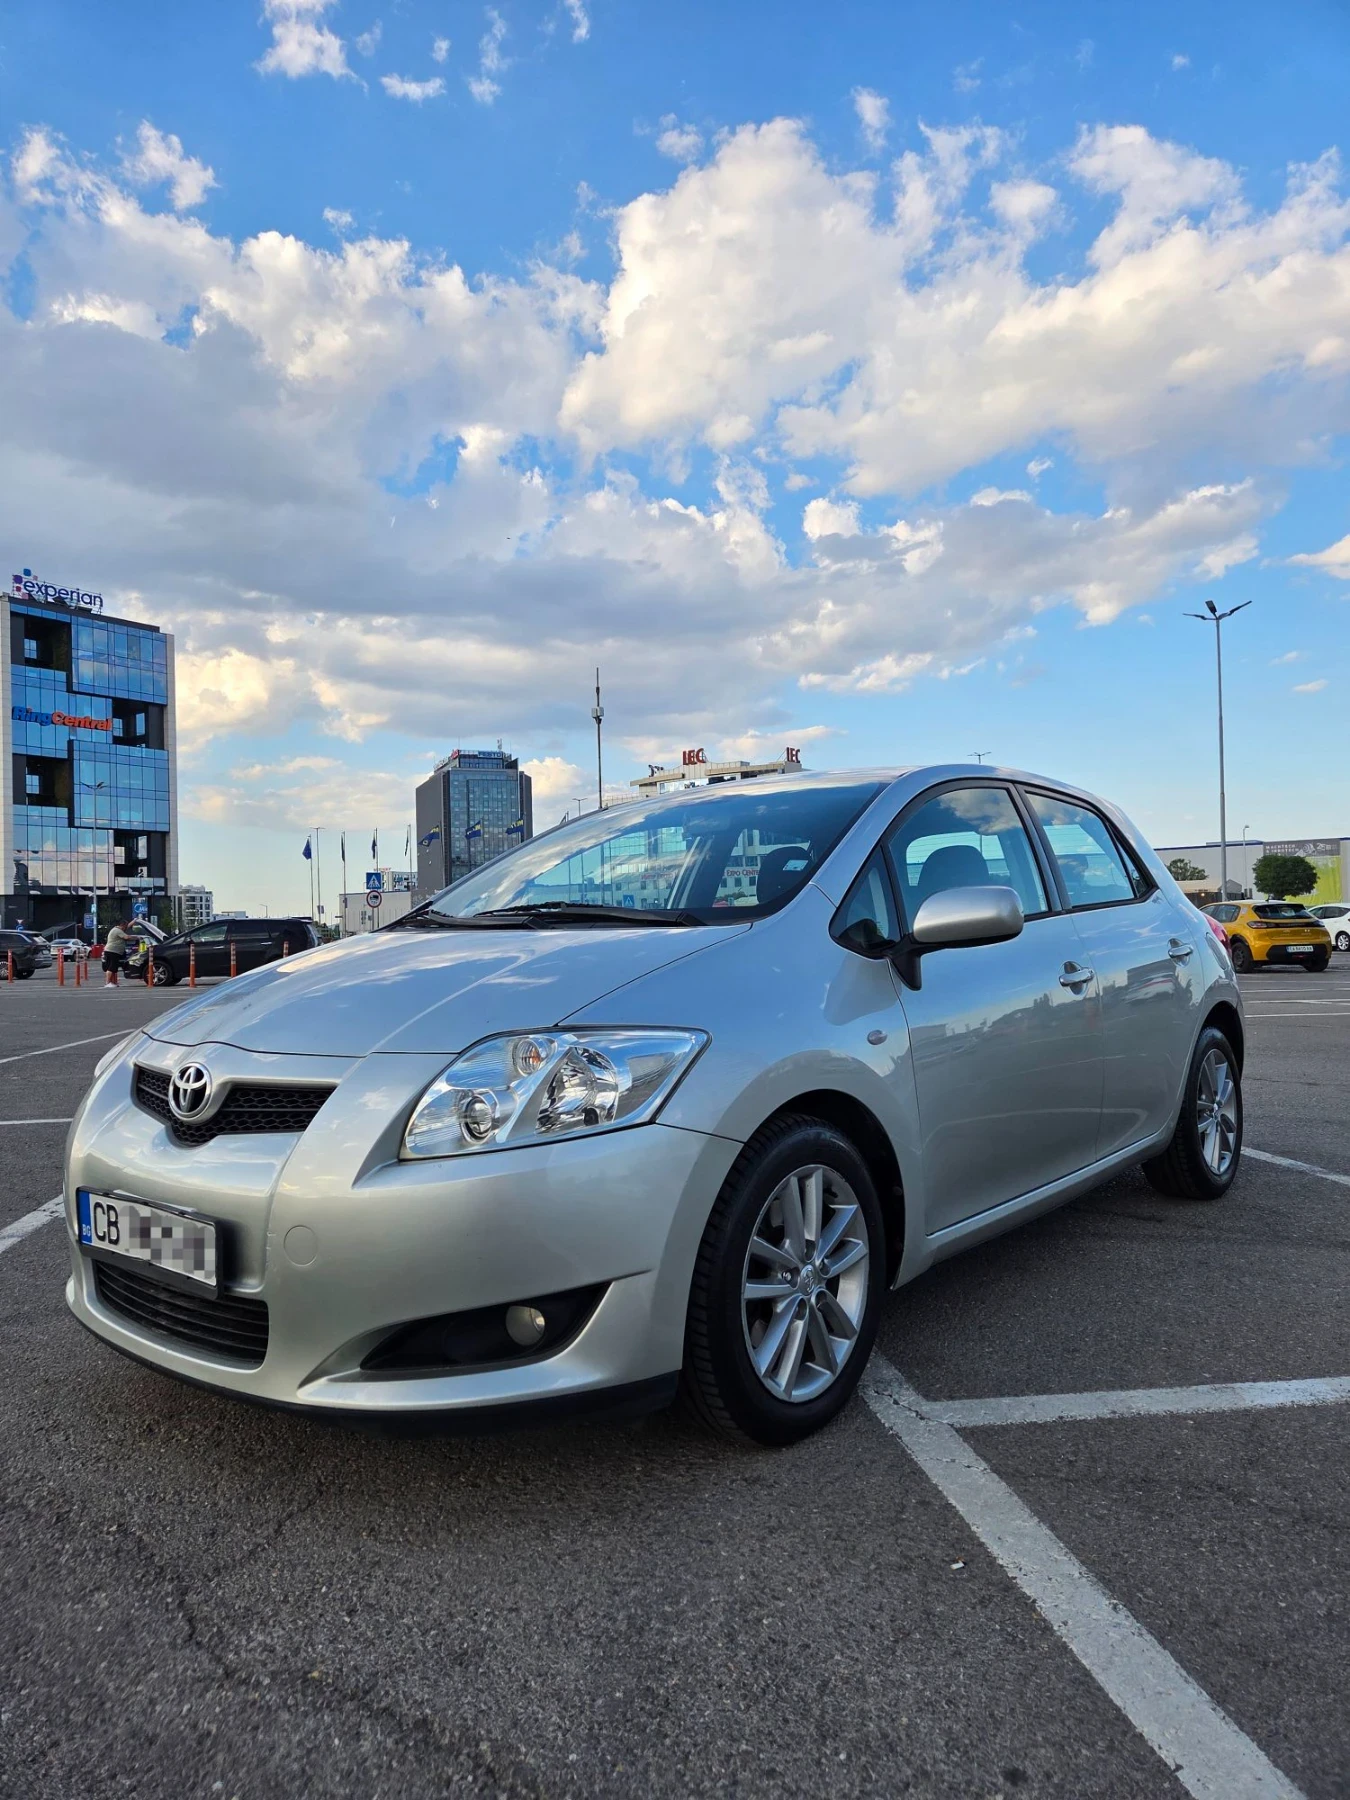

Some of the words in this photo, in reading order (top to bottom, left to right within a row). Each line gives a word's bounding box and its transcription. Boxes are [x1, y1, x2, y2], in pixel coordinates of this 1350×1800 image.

[23, 580, 104, 608] experian
[12, 706, 112, 732] RingCentral
[682, 748, 706, 766] IEC
[786, 747, 800, 764] IEC
[742, 869, 760, 877] CENTE
[82, 1223, 92, 1238] BG
[93, 1201, 120, 1246] CB
